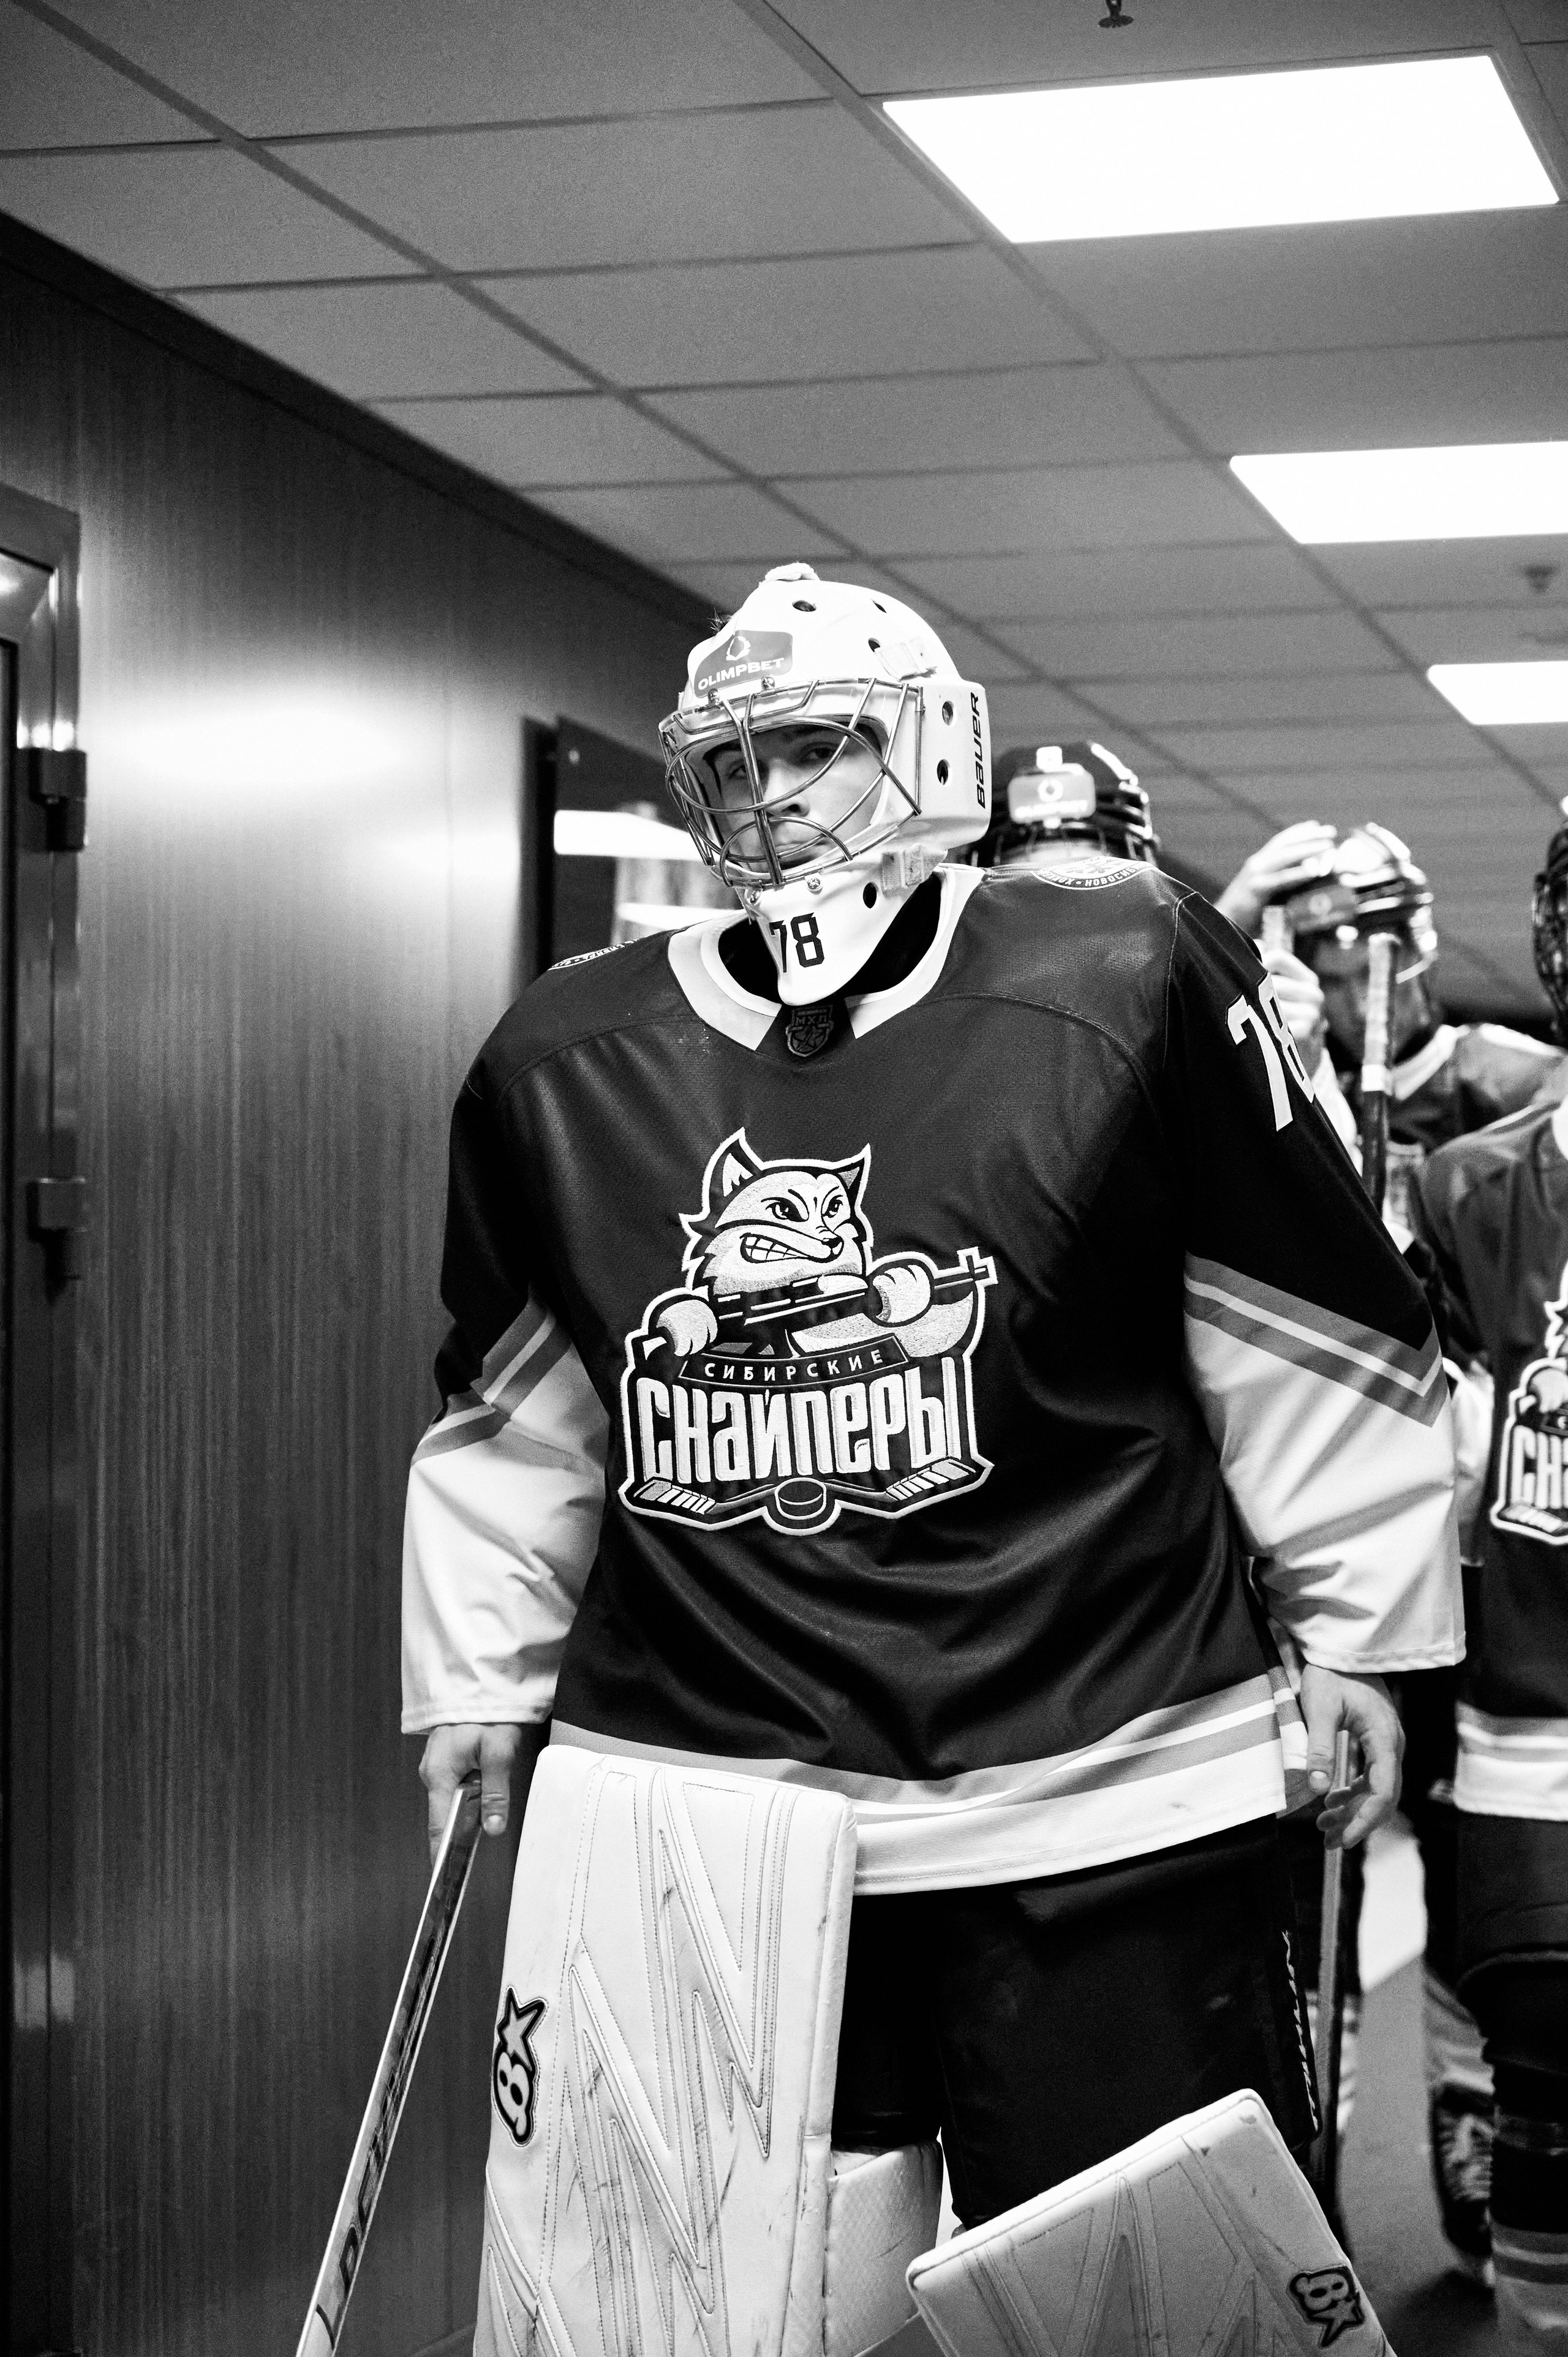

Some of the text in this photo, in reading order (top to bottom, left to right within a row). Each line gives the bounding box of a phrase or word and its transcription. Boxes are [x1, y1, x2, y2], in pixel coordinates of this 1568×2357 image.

[698, 657, 785, 690] OLIMPBET
[769, 912, 824, 973] 78
[1227, 972, 1316, 1132] 78
[704, 1349, 883, 1382] СИБИРСКИЕ
[1510, 1424, 1567, 1509] СН
